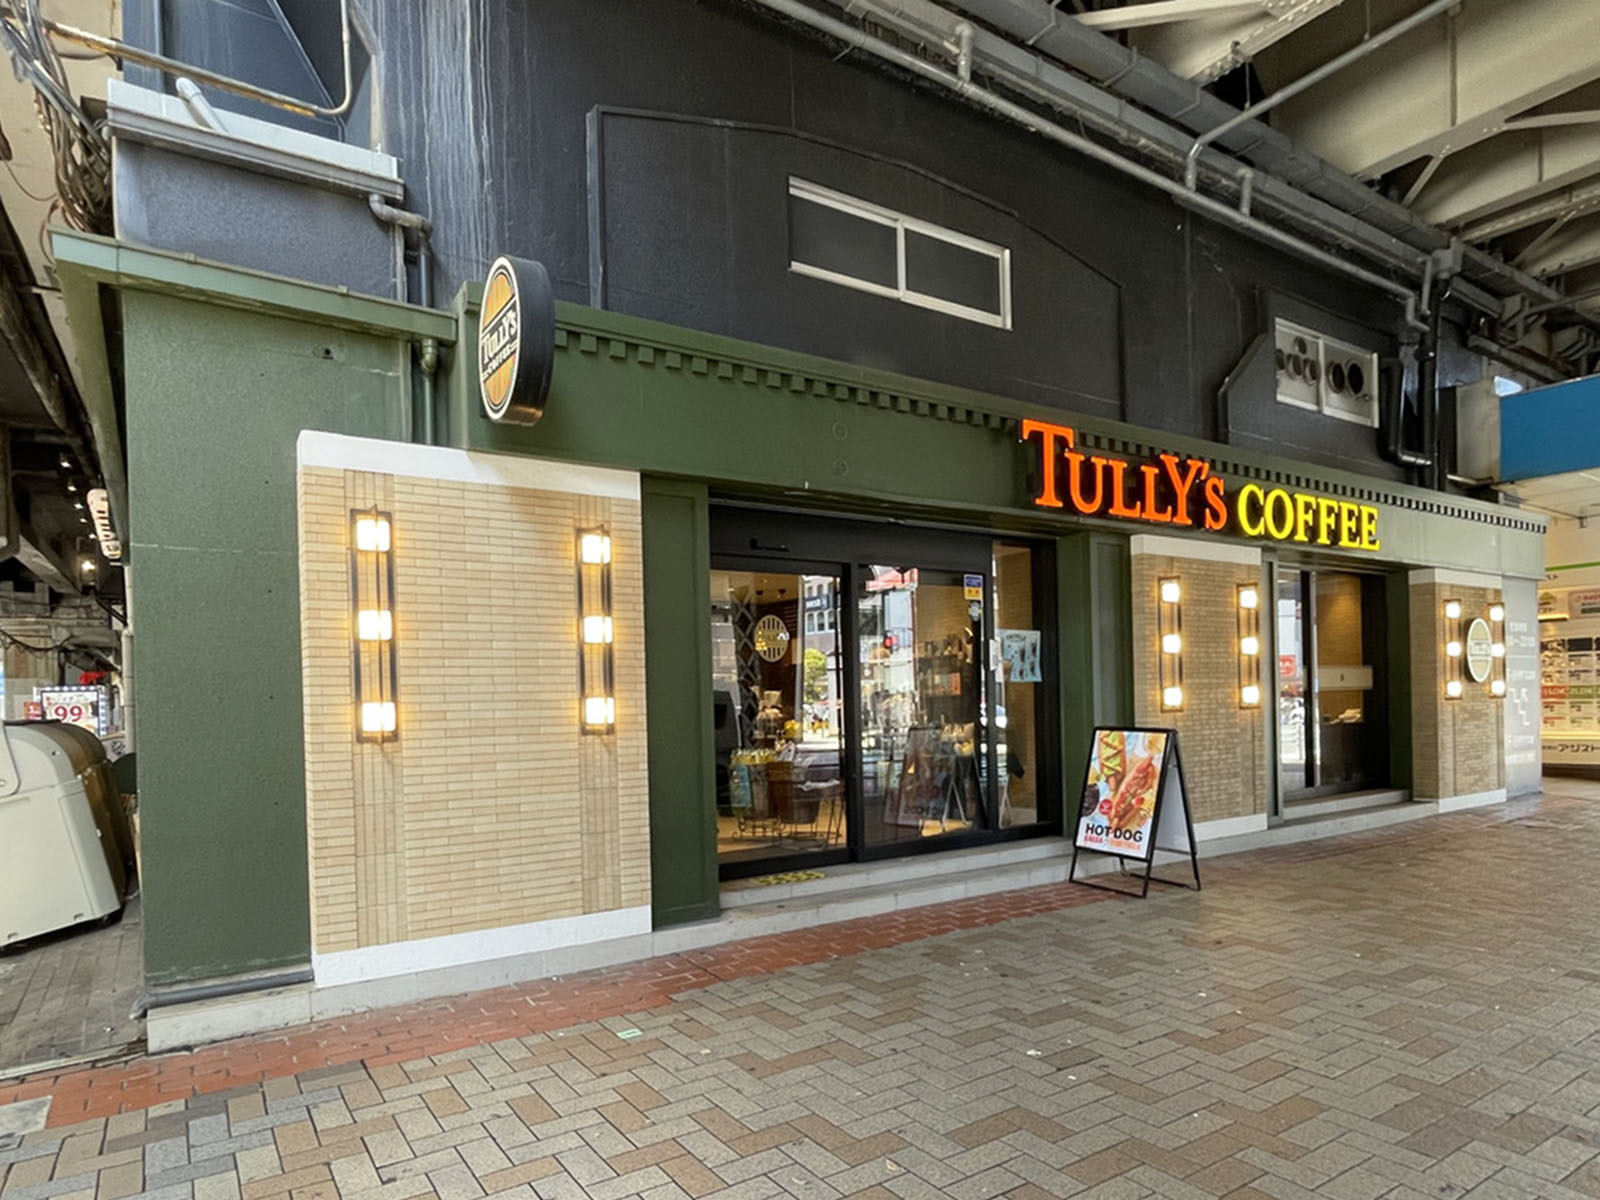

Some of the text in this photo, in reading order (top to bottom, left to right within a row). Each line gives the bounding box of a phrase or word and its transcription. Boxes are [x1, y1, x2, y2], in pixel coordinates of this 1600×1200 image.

[1237, 483, 1381, 551] COFFEE
[1084, 823, 1112, 837] HOT
[1113, 827, 1143, 843] DOG
